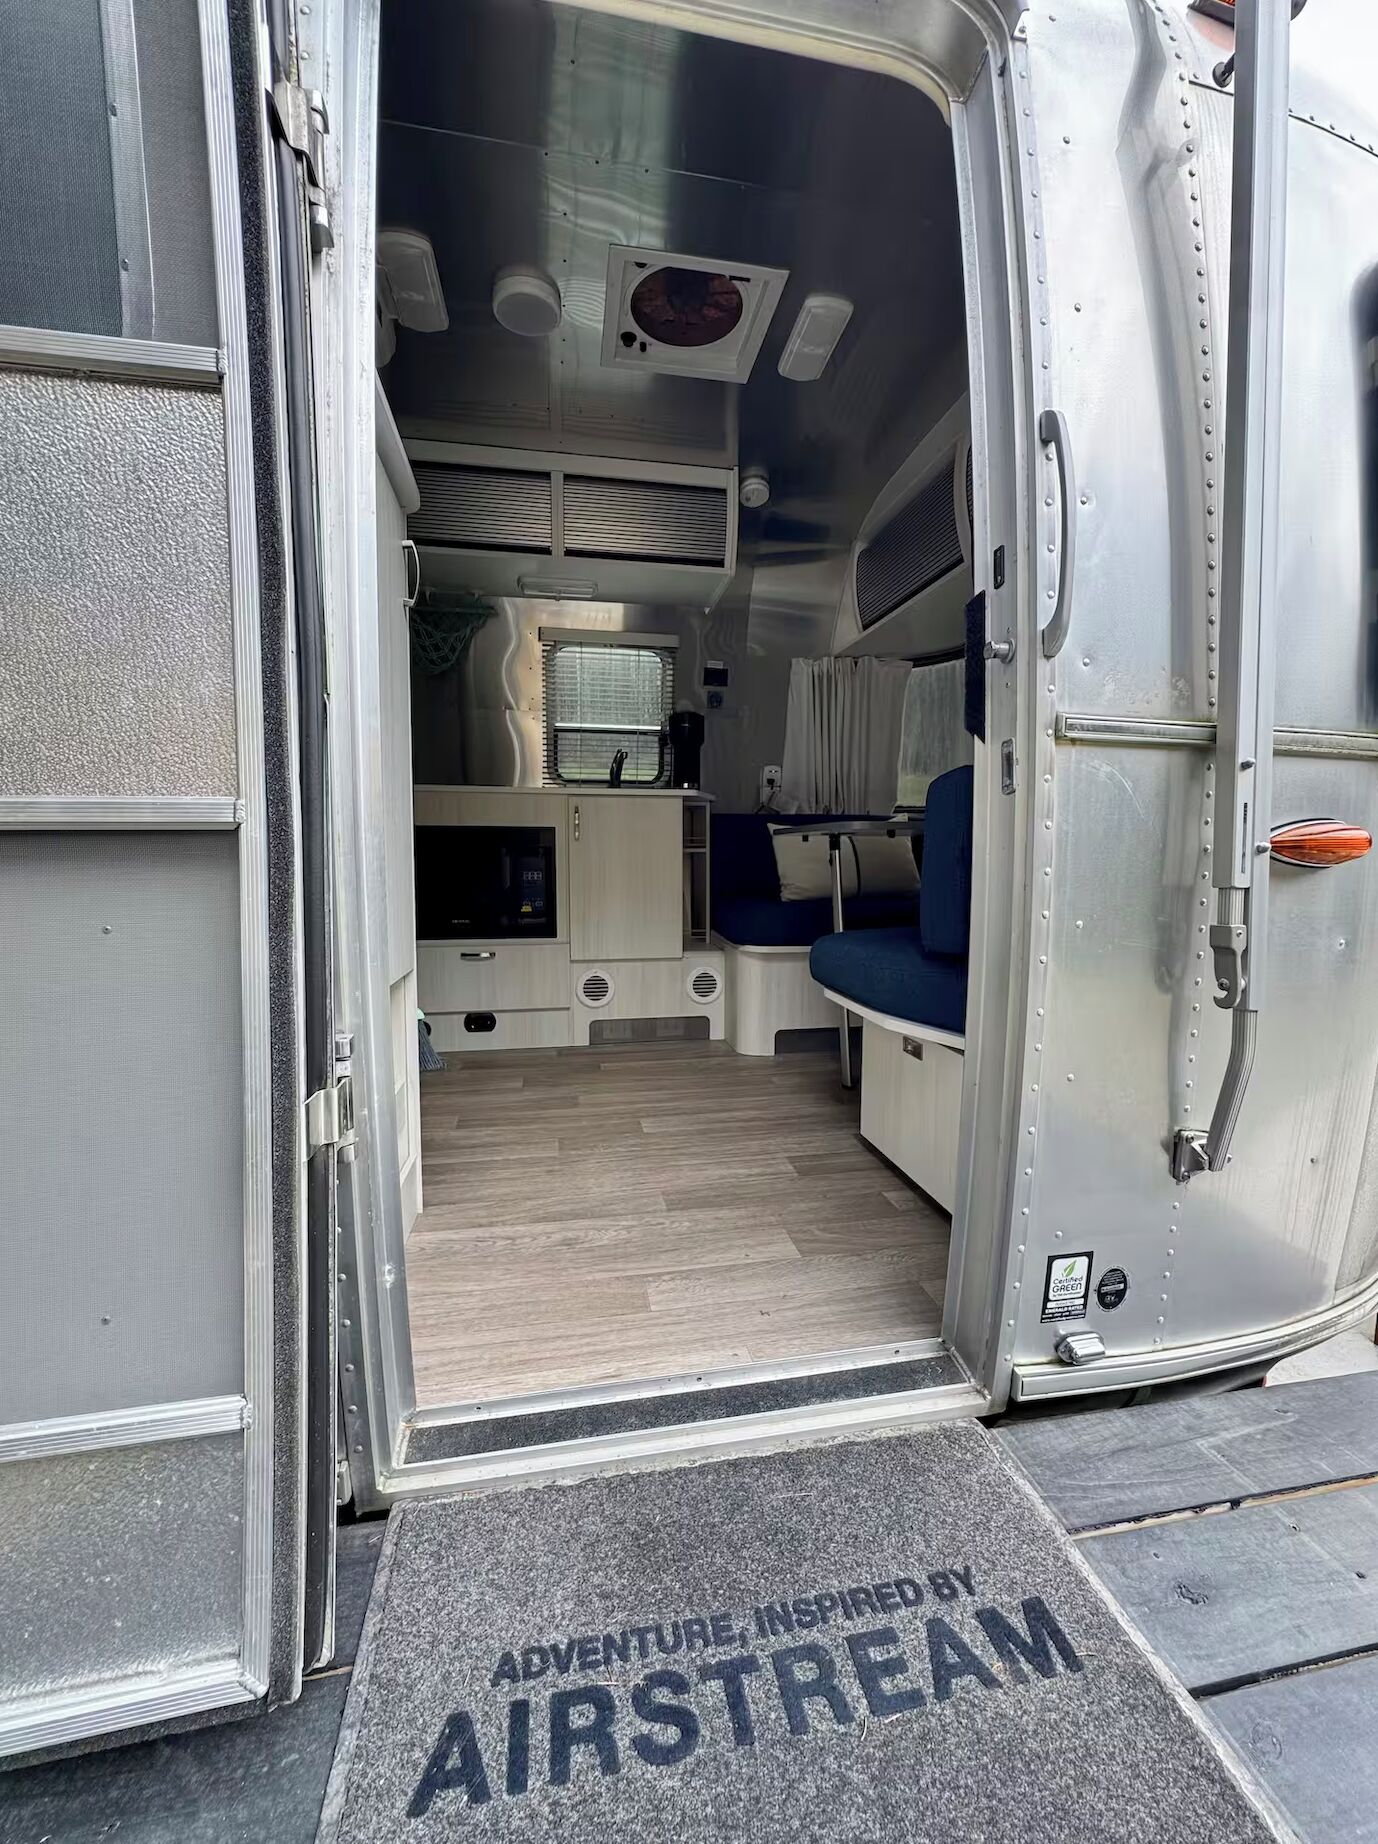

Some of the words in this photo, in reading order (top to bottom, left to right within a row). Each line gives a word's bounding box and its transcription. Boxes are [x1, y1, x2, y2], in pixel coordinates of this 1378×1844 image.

[1053, 1276, 1083, 1285] Certified
[490, 1612, 749, 1687] ADVENTURE,
[755, 1577, 924, 1639] INSPIRED
[928, 1565, 976, 1601] BY
[407, 1596, 1084, 1818] AIRSTREAM
